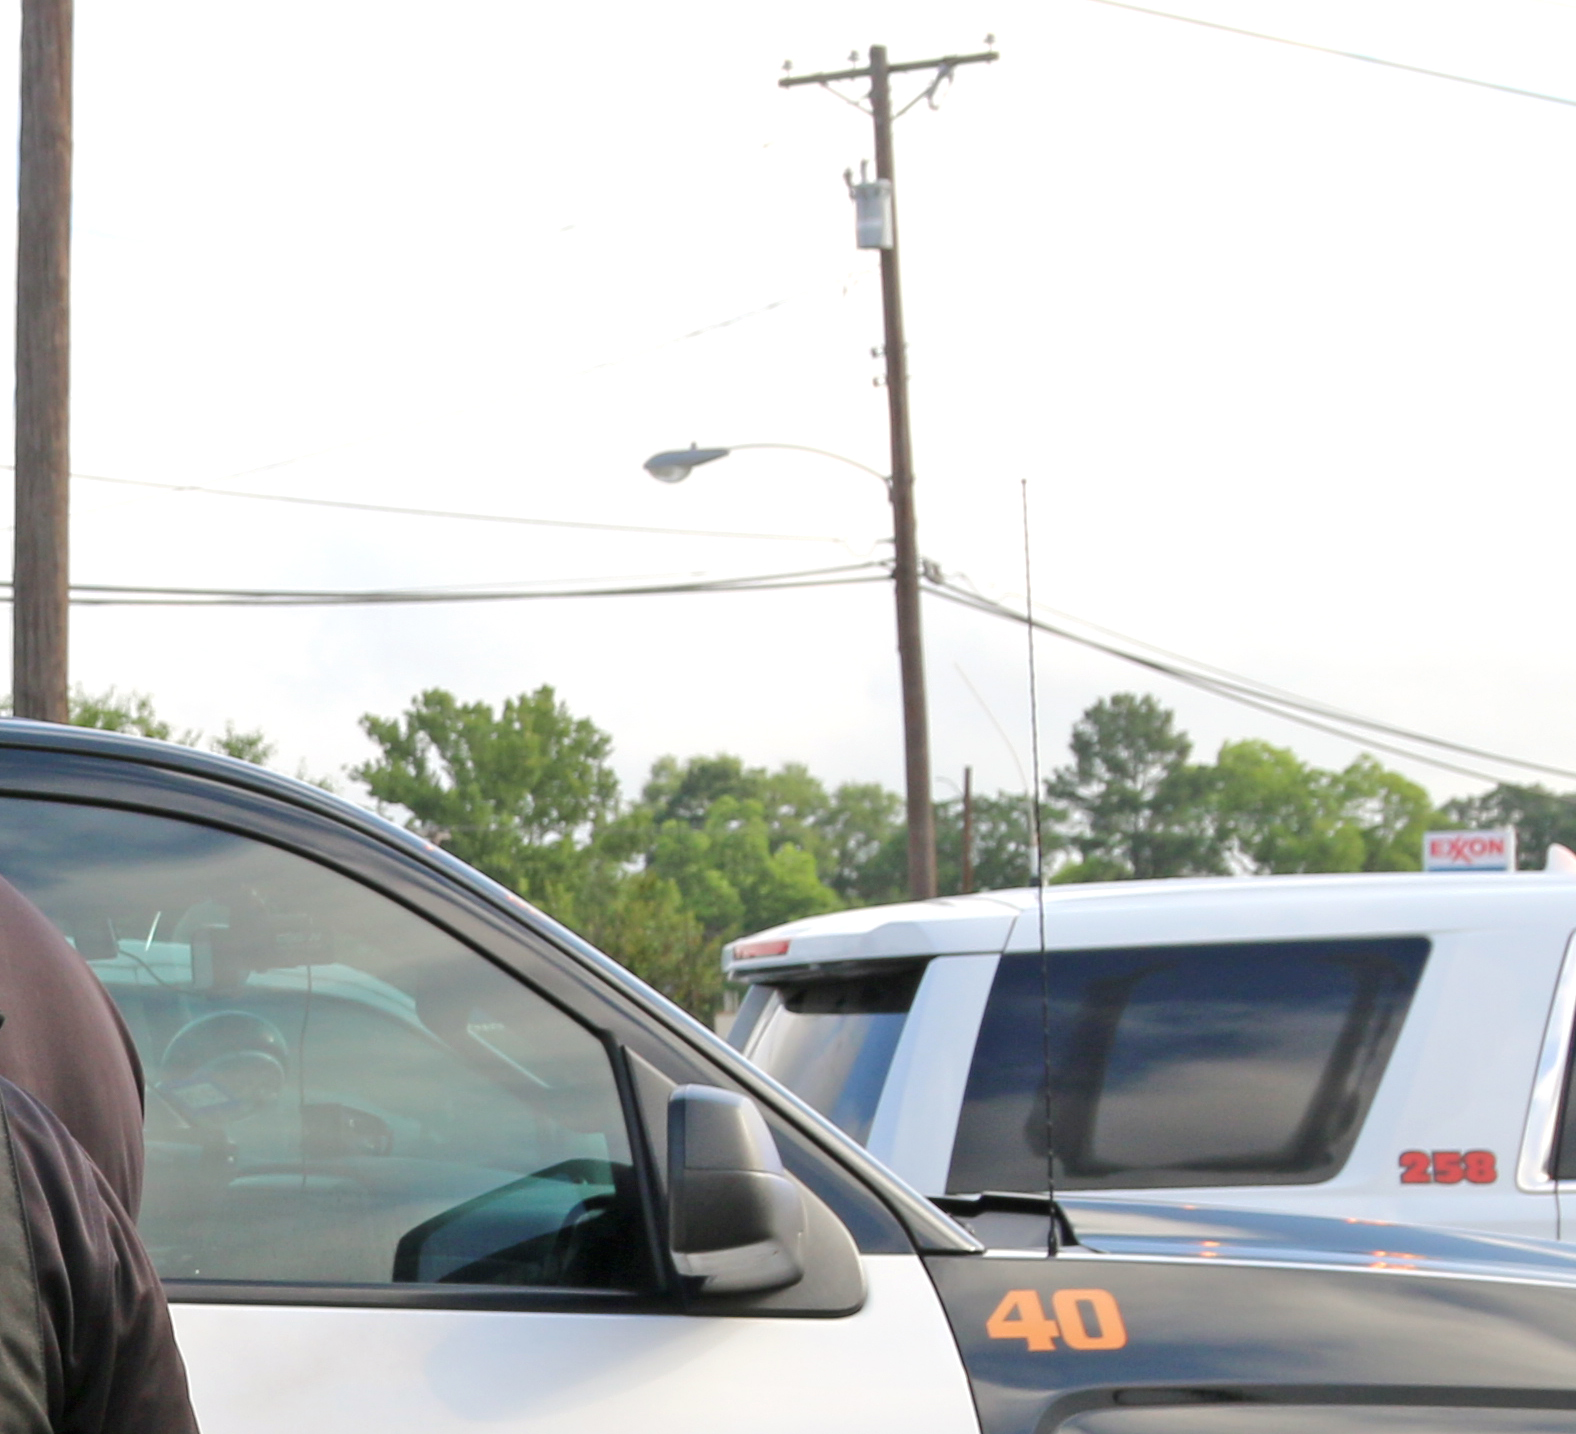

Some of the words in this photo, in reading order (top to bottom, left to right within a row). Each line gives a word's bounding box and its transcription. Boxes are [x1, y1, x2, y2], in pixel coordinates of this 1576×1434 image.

[1430, 834, 1505, 865] EXXON
[1399, 1150, 1498, 1185] 258
[986, 1288, 1129, 1352] 40
